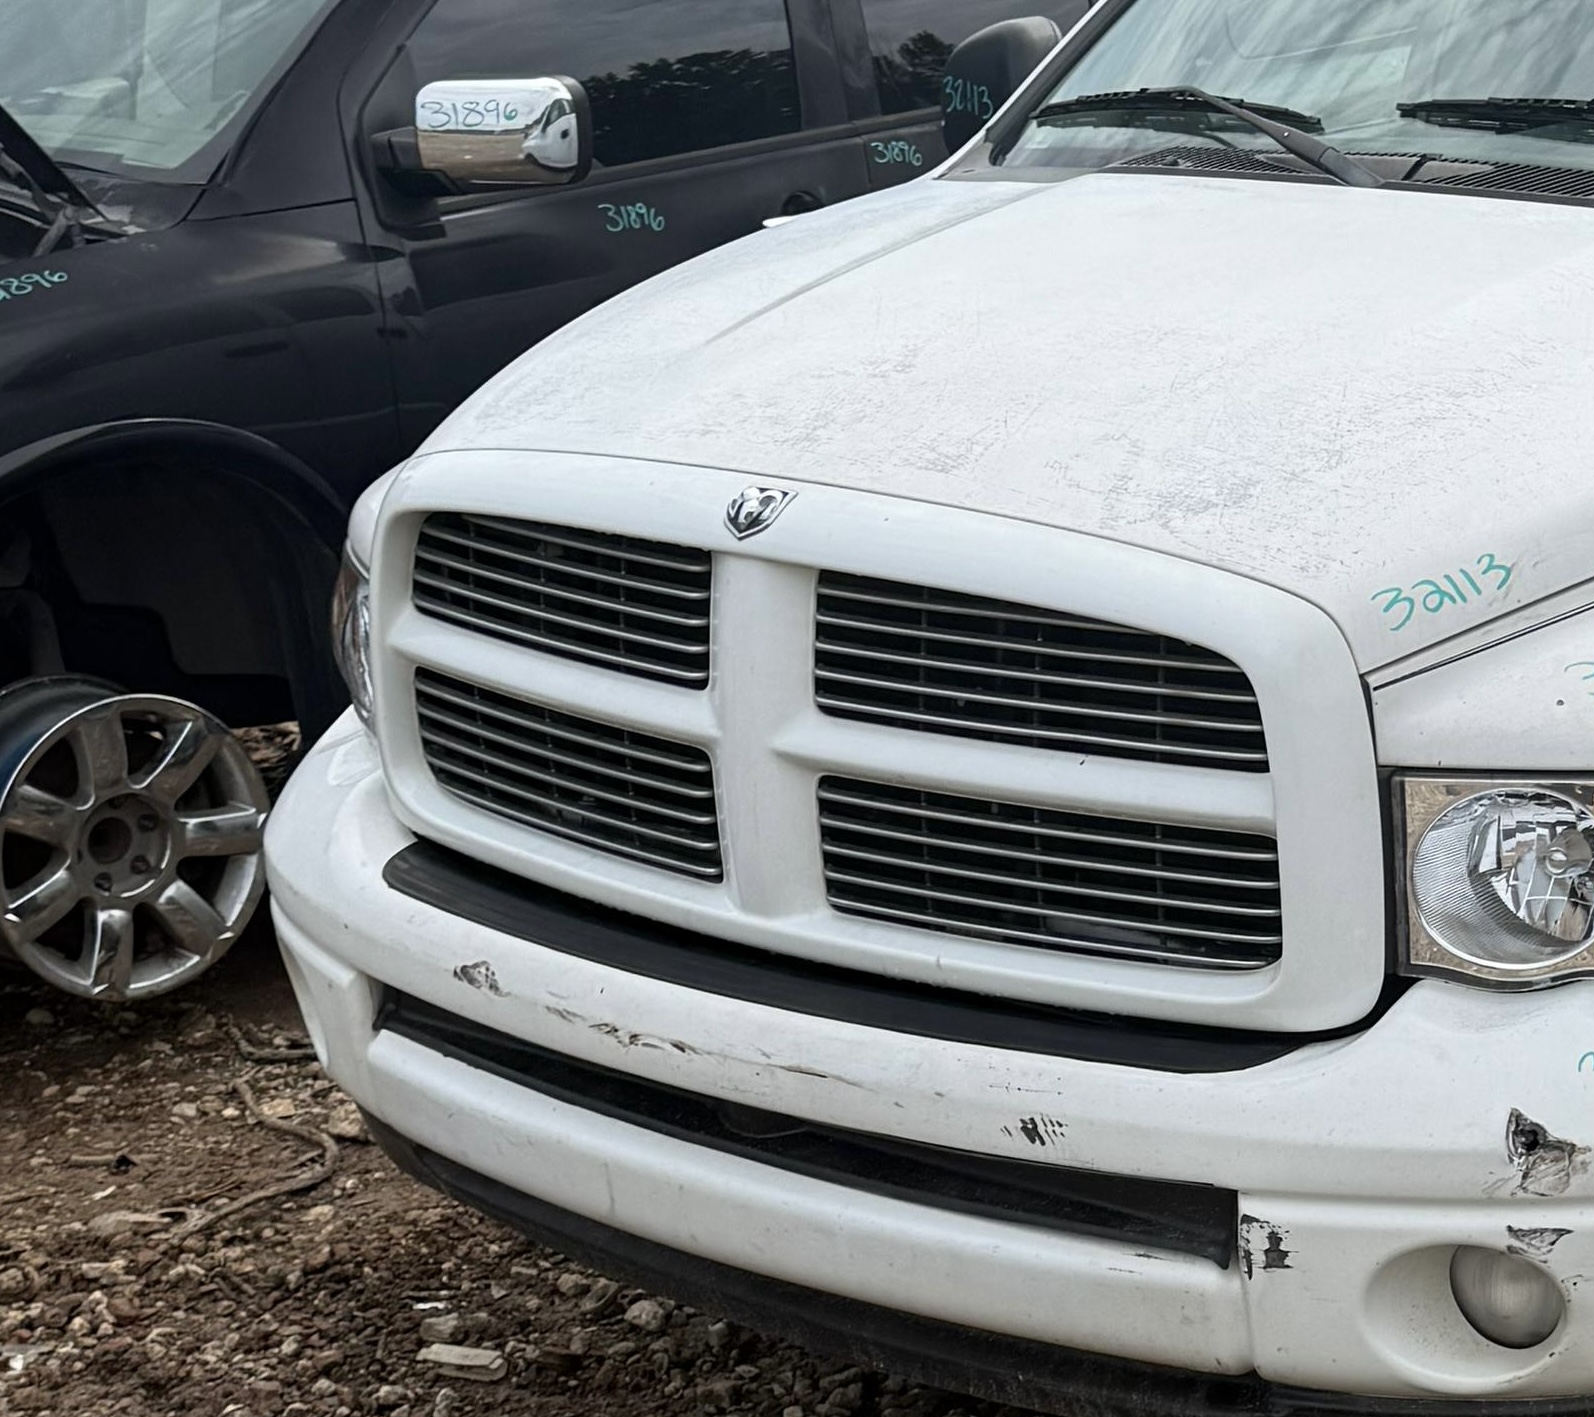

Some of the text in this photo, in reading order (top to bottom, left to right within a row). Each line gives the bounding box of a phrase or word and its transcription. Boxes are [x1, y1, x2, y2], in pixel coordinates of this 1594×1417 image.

[942, 76, 994, 119] 32113
[420, 98, 518, 128] 31896
[870, 141, 923, 166] 31896
[598, 203, 666, 232] 31896
[0, 270, 68, 301] 896
[1371, 553, 1513, 632] 32113
